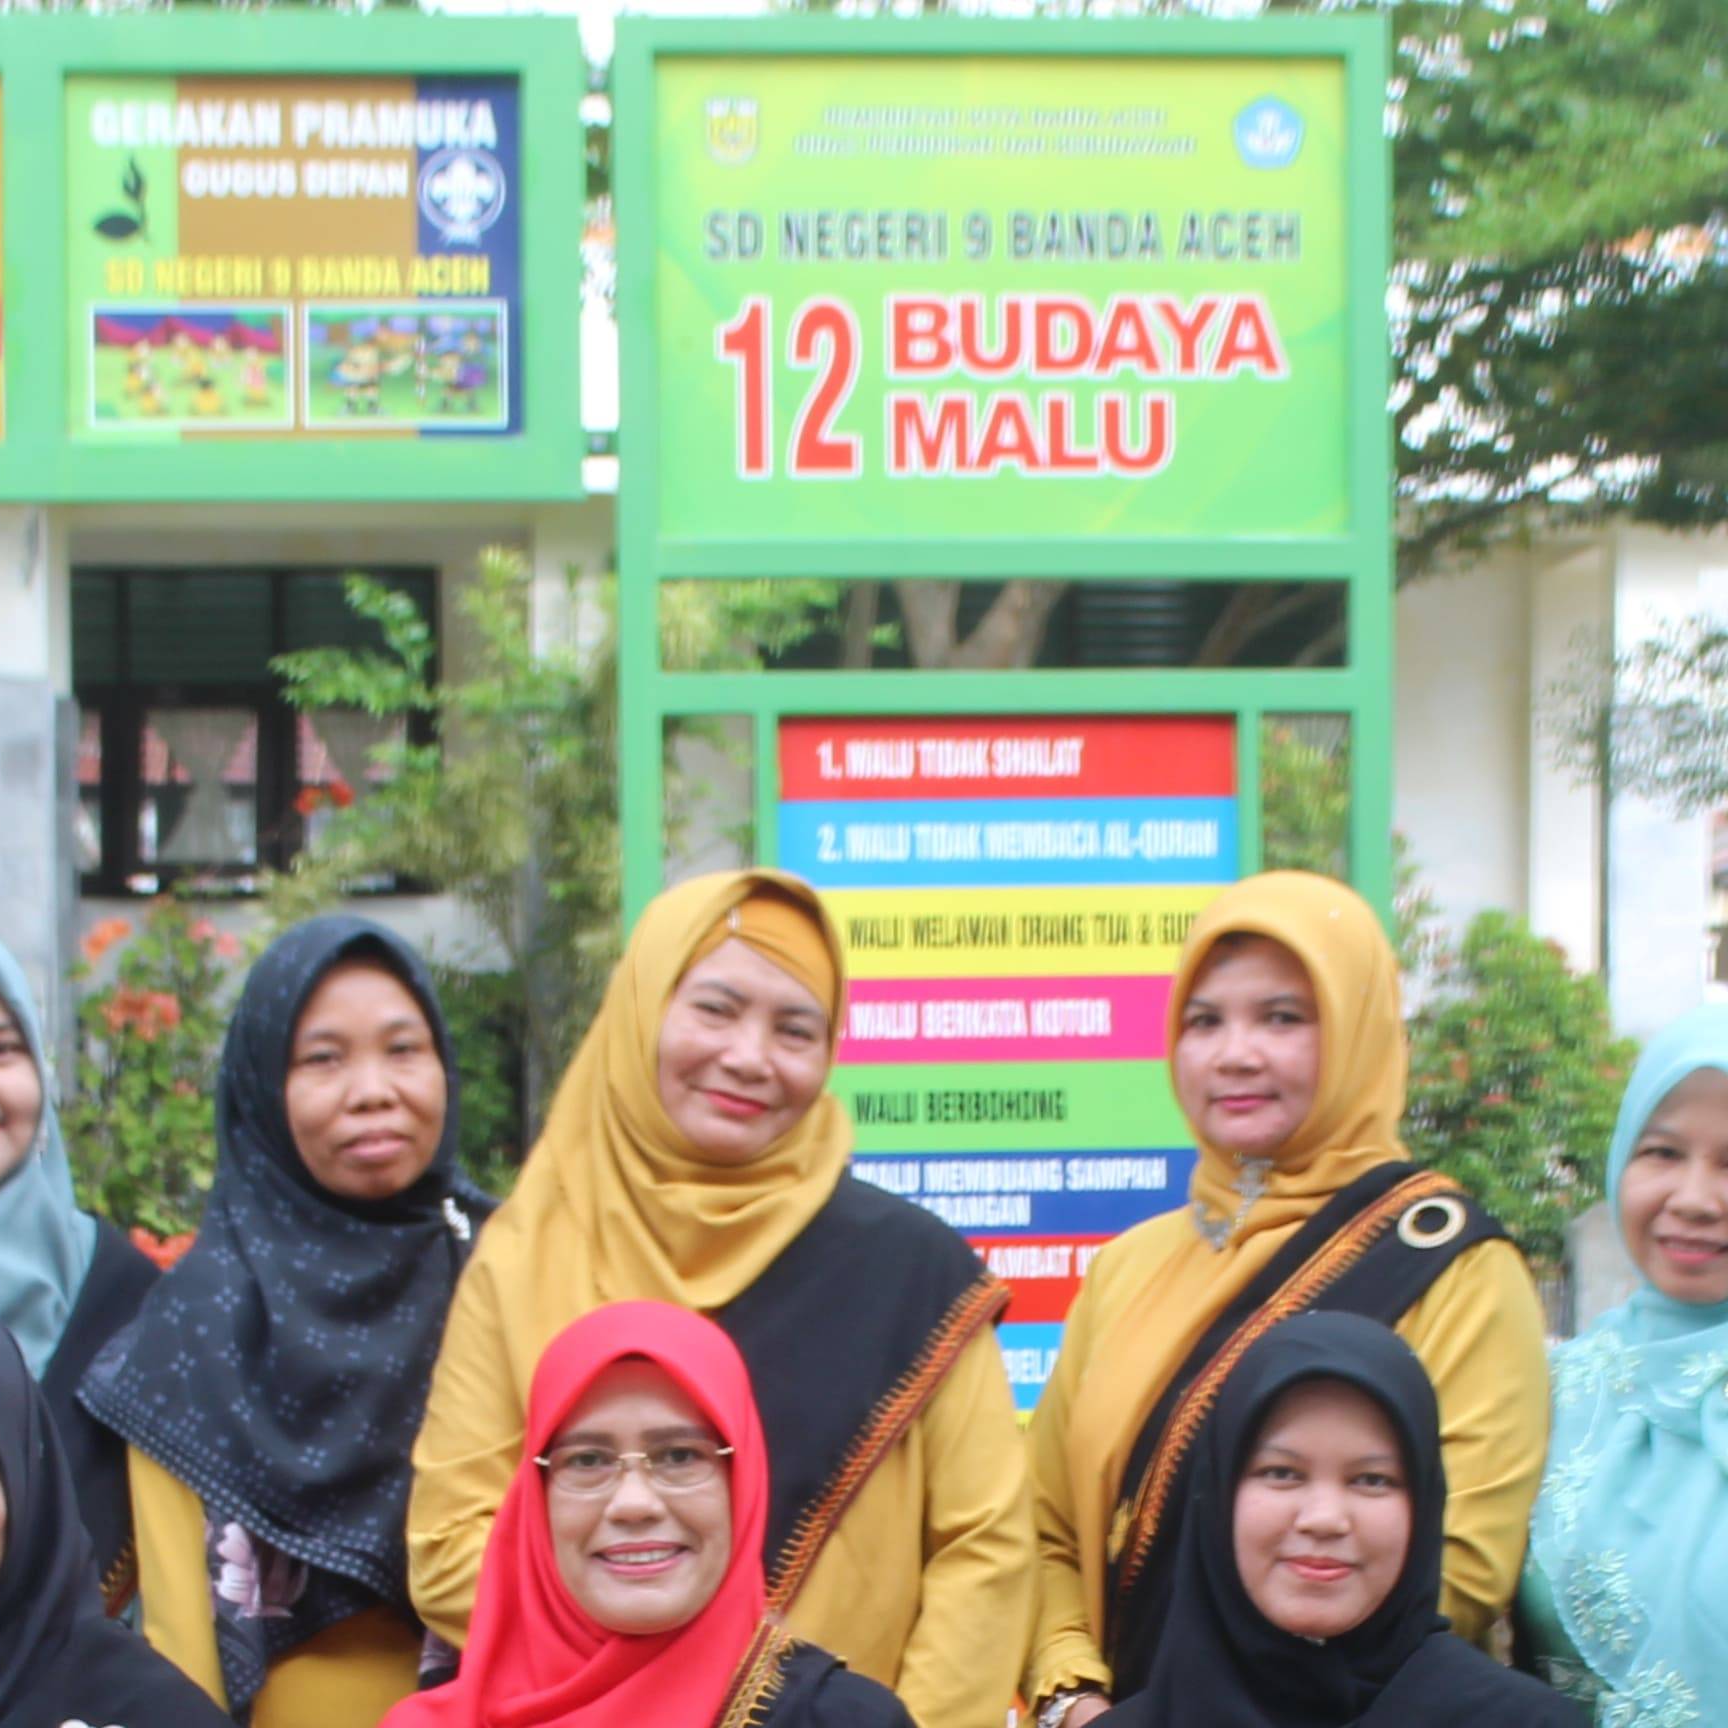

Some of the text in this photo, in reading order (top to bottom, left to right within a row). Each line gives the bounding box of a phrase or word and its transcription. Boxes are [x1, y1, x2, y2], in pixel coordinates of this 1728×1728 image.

[293, 100, 498, 149] PRAMUKA
[704, 212, 1303, 261] SD NEGERI 9 BANDA ACEH
[105, 255, 490, 297] SD NEGERI 9 BANDA ACEH
[721, 297, 1285, 474] 12 BUDAYA
[888, 396, 1171, 474] MALU
[845, 739, 915, 779] MALU
[917, 738, 991, 778] TIDAK
[845, 825, 911, 861] MALU
[913, 824, 981, 861] TIDAK
[849, 916, 902, 949] MALU
[912, 914, 1009, 949] MELAWAN
[849, 1001, 917, 1039] MALU
